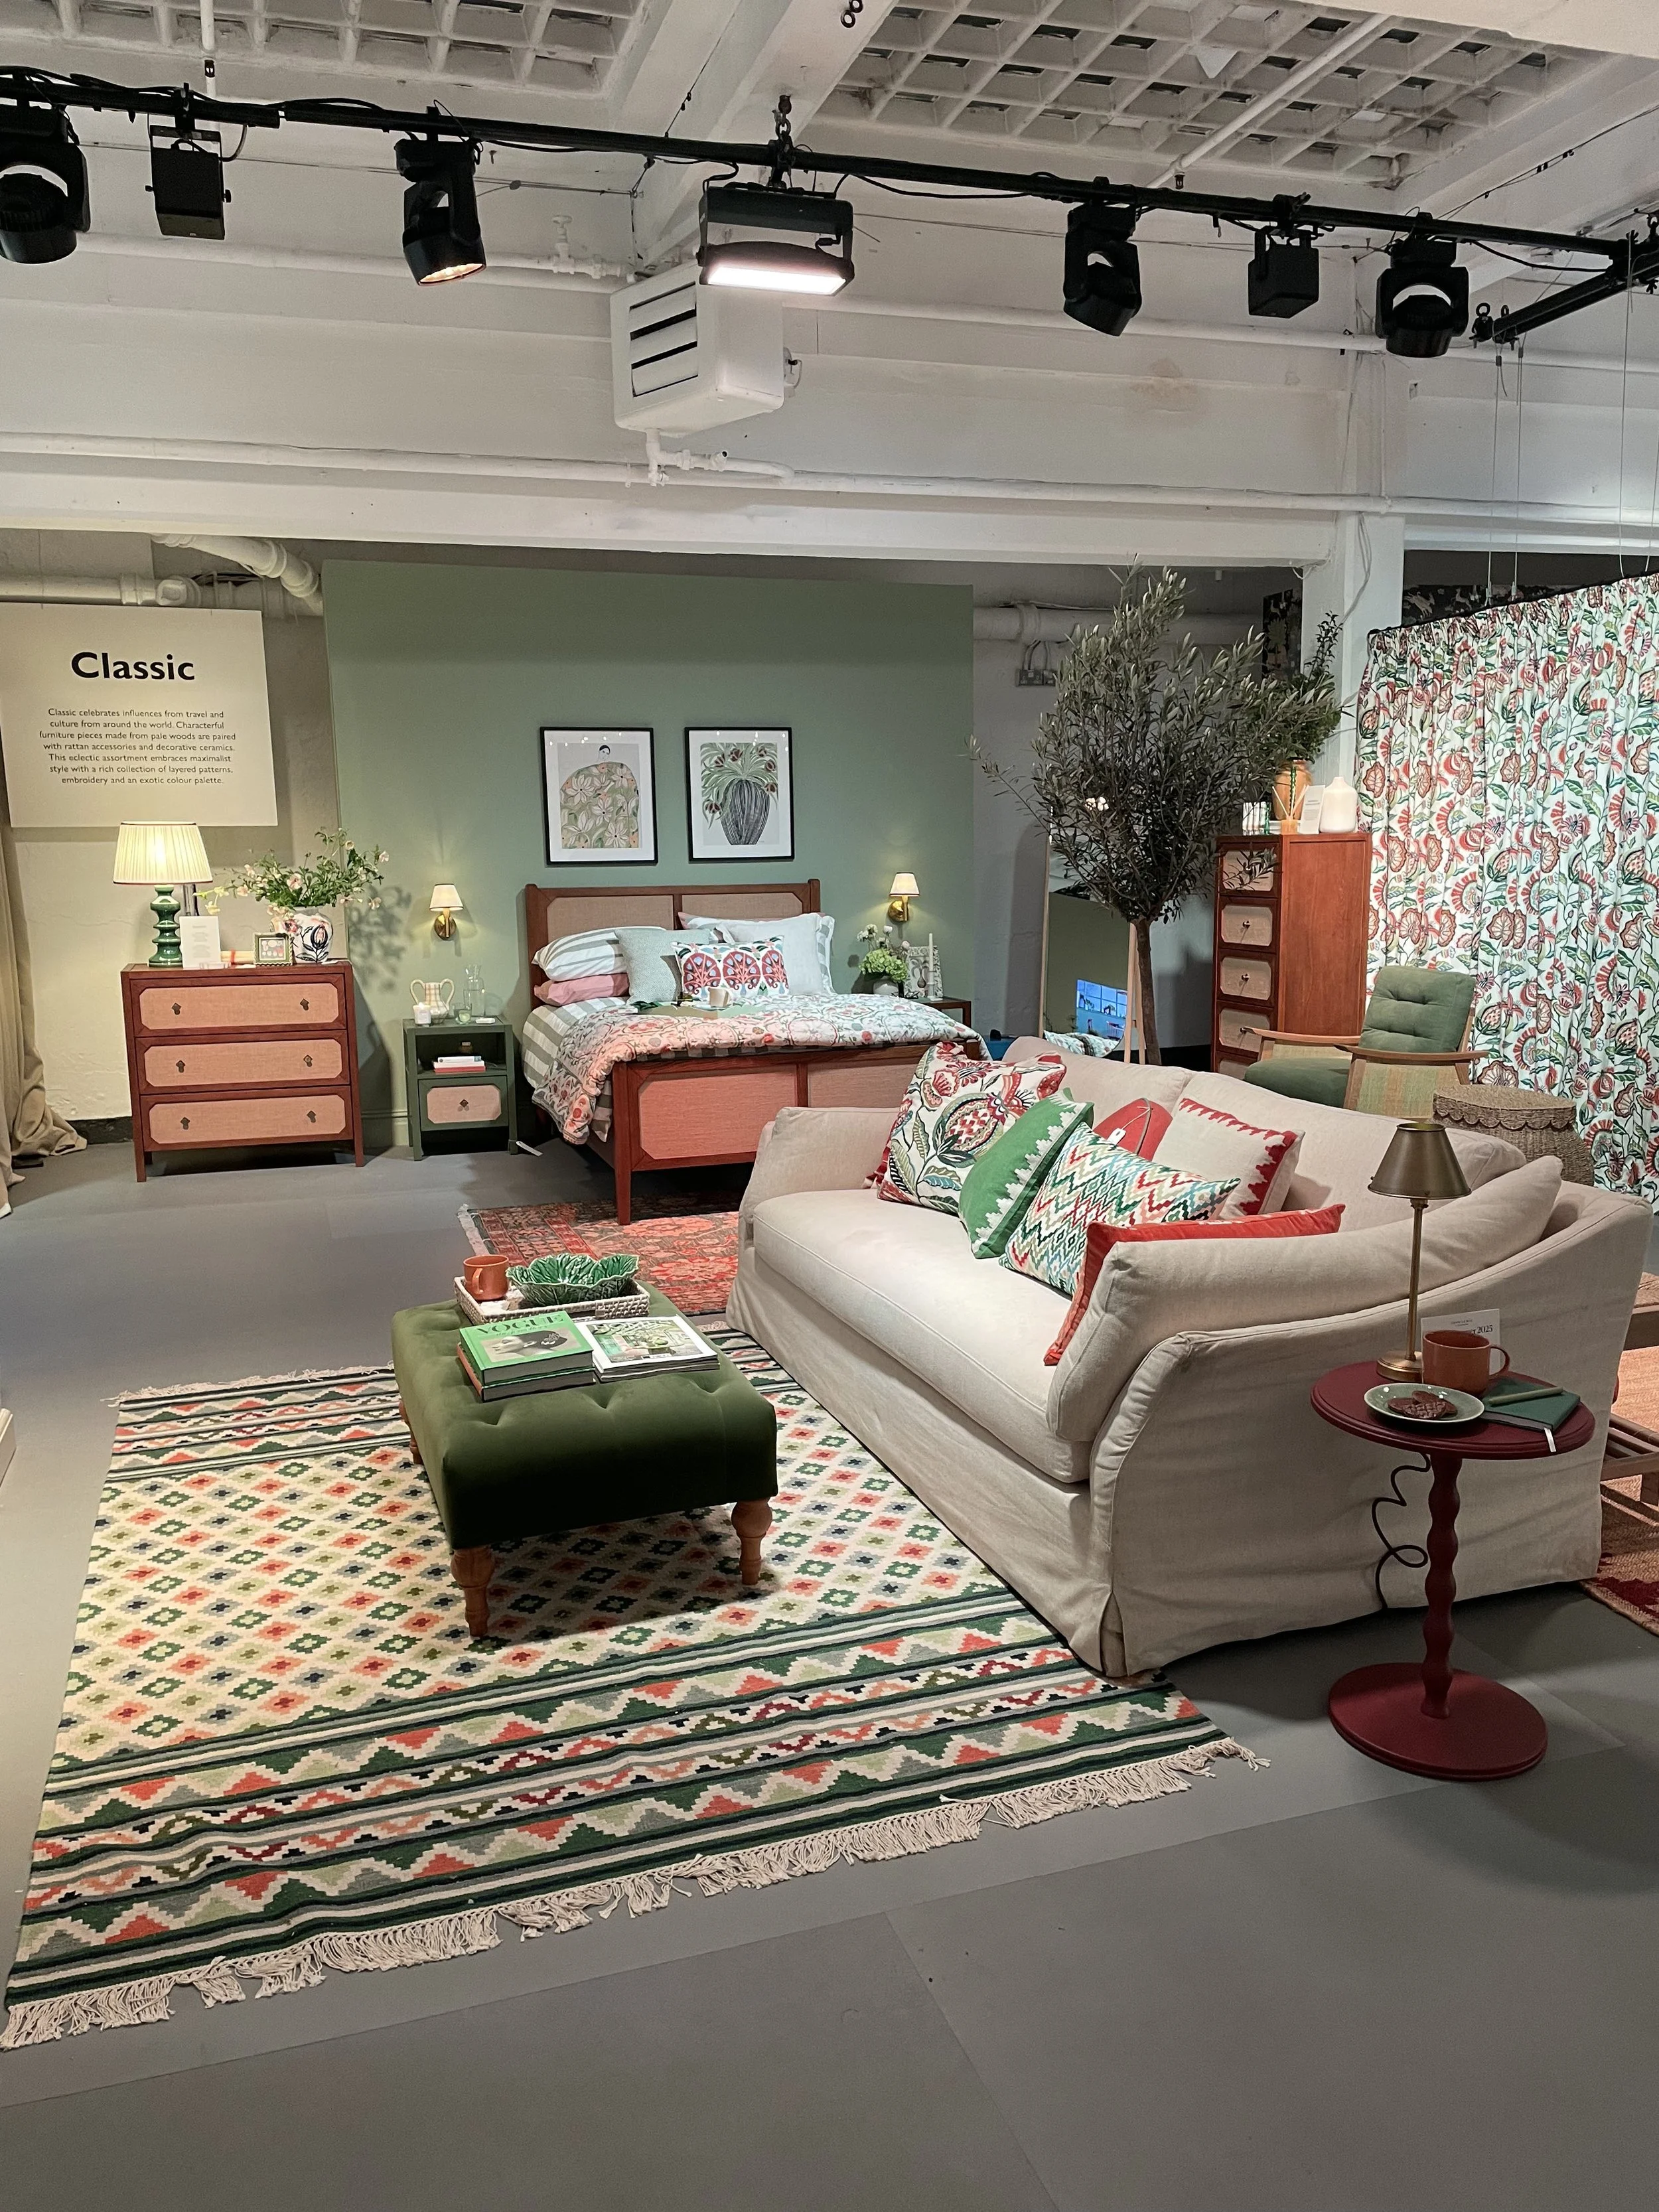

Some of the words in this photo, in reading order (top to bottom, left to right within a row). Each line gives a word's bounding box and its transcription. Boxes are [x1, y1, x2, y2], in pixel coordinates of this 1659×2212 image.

[71, 651, 195, 680] Classic
[48, 708, 76, 717] Classic
[123, 709, 162, 717] influences
[77, 732, 103, 741] pieces
[151, 732, 167, 741] pale
[212, 733, 236, 741] paired
[49, 765, 68, 774] style
[169, 766, 196, 774] layered
[62, 776, 108, 785] embroidery
[194, 777, 224, 786] palette.
[476, 1314, 563, 1334] VOGUE
[1477, 1325, 1493, 1334] 2025
